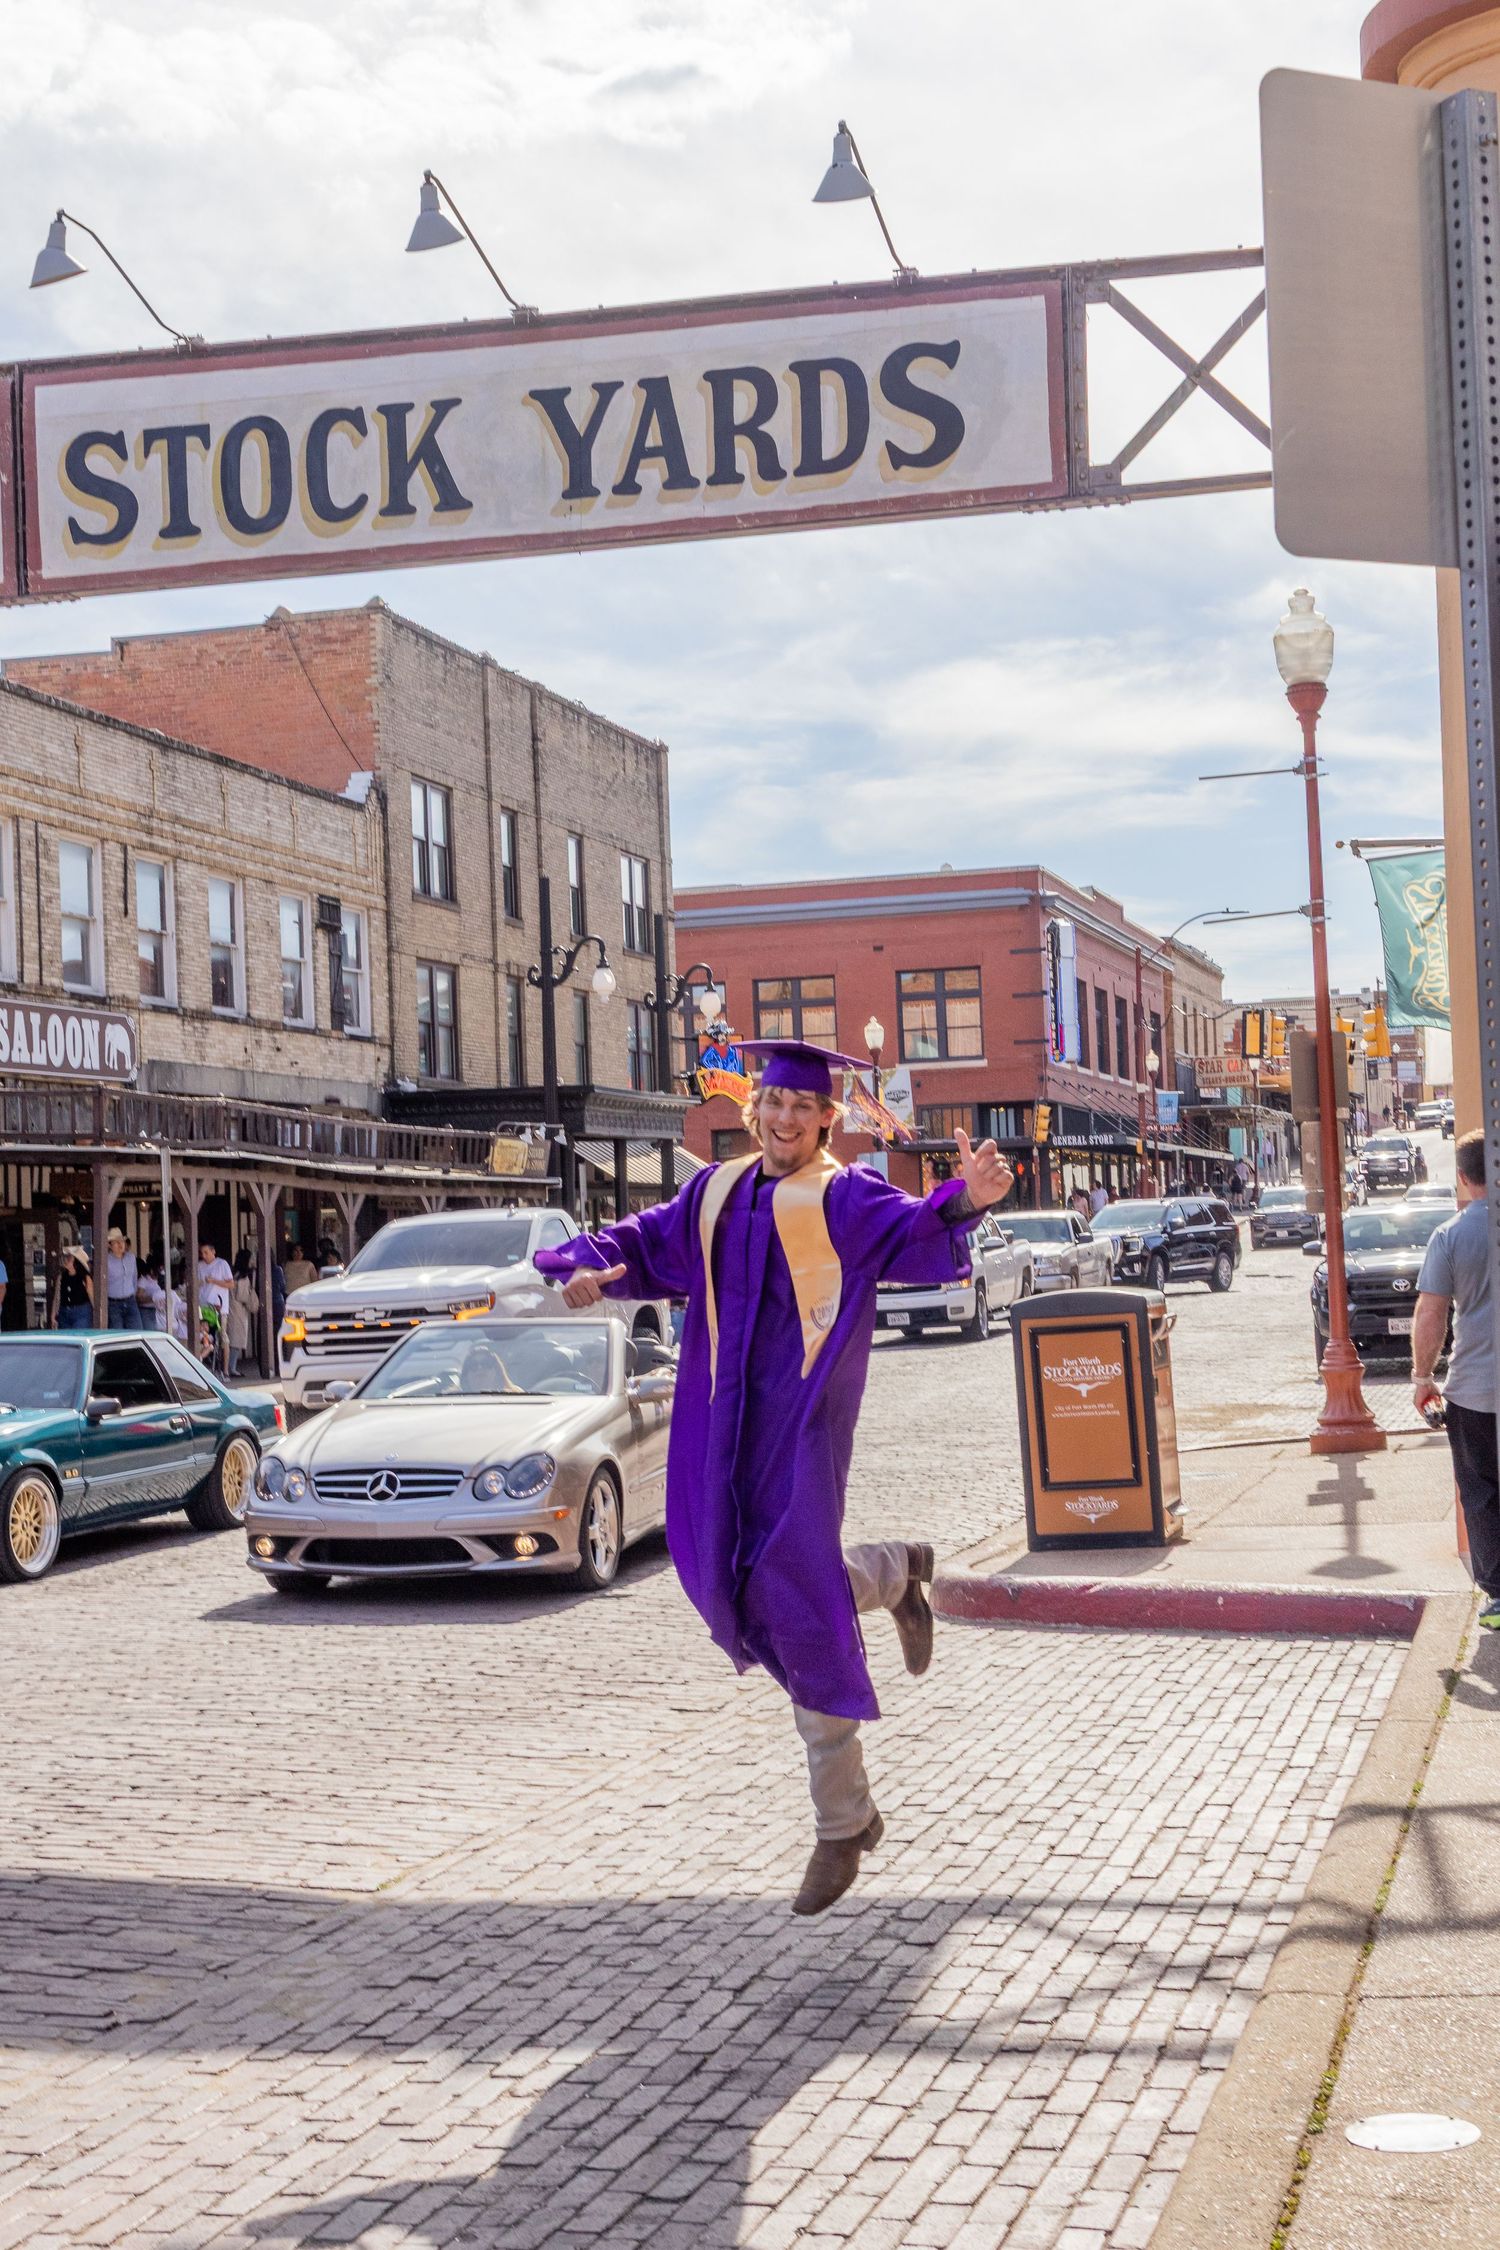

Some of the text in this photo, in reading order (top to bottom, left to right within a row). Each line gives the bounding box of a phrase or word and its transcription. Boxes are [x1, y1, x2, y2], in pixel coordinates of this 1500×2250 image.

[60, 338, 967, 556] STOCK YARDS
[1197, 1058, 1223, 1074] STAR
[1052, 1134, 1114, 1146] GENERAL STORE
[1063, 1356, 1100, 1366] Fort Worth
[1043, 1362, 1122, 1380] STOCKYARDS
[1065, 1499, 1119, 1511] STOCKYARDS
